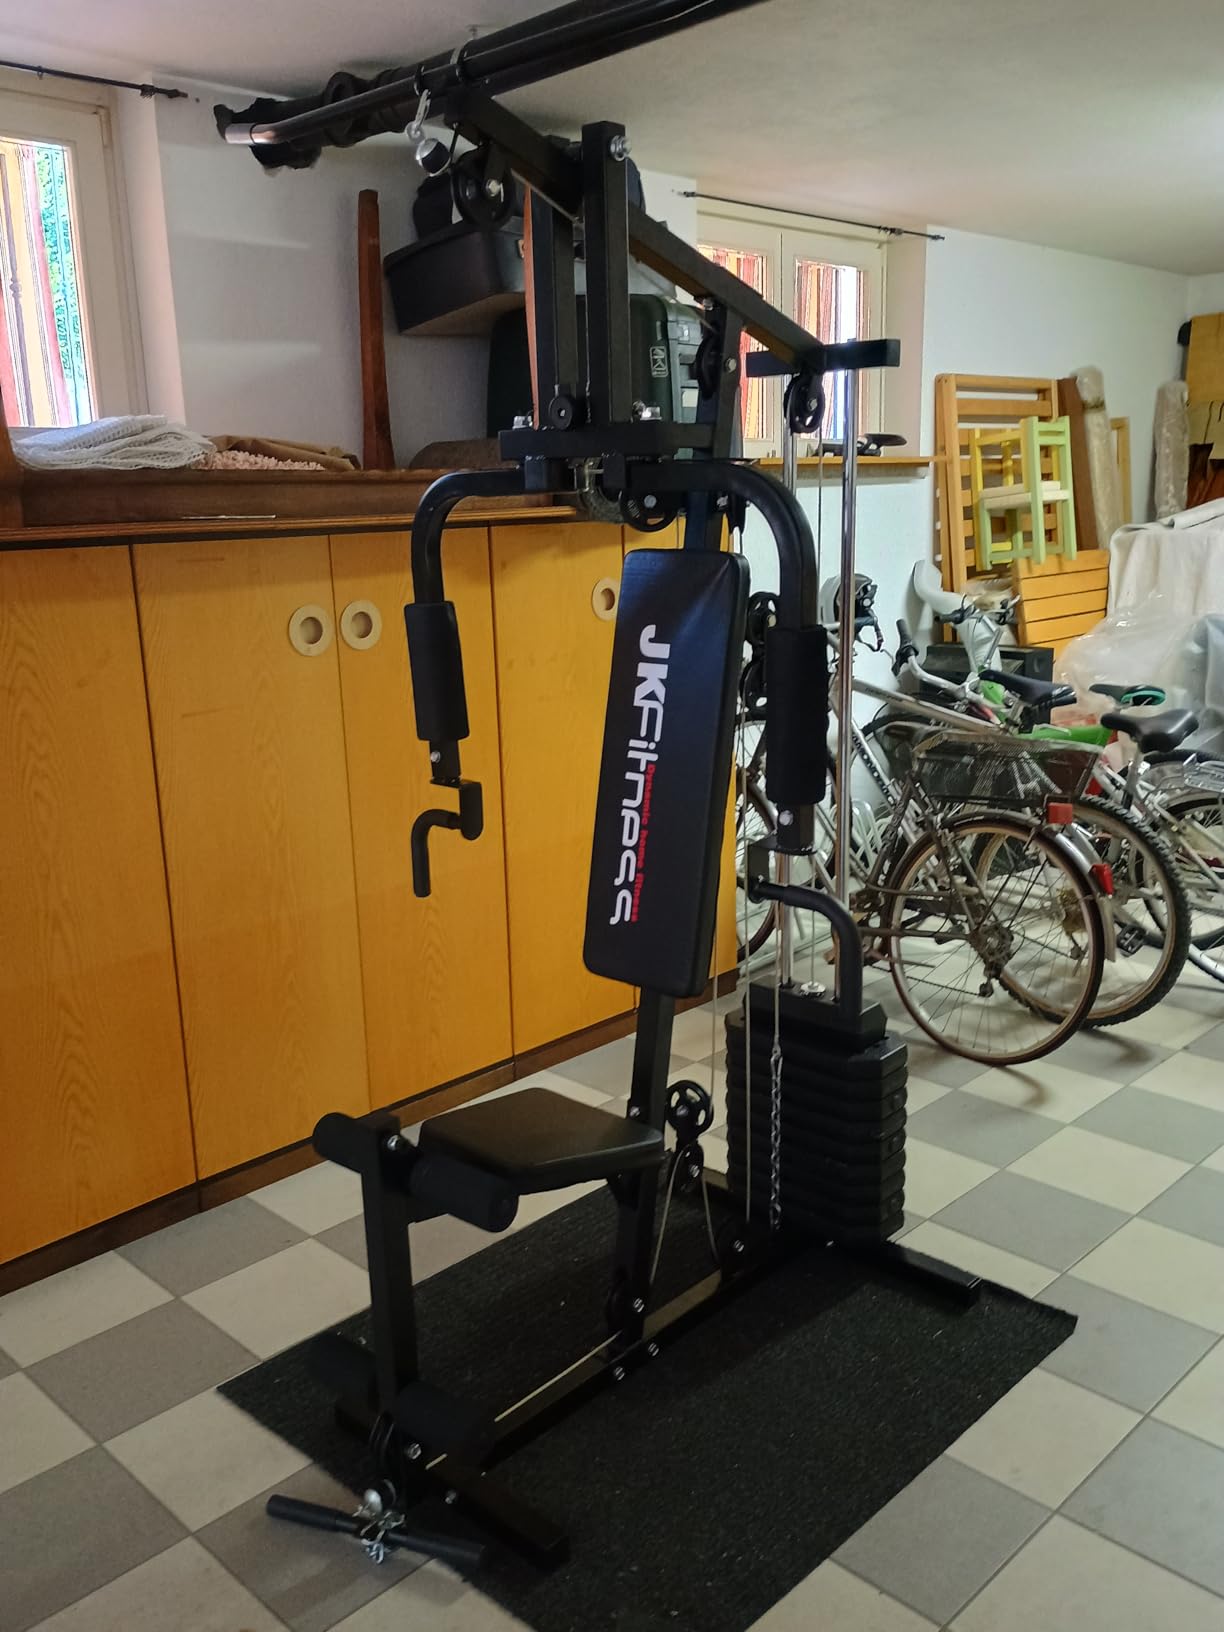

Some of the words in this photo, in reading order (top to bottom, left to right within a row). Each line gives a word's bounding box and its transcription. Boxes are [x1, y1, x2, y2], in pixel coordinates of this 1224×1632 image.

[609, 624, 671, 925] JKFitness
[642, 763, 656, 825] Dynamic
[637, 829, 649, 869] home
